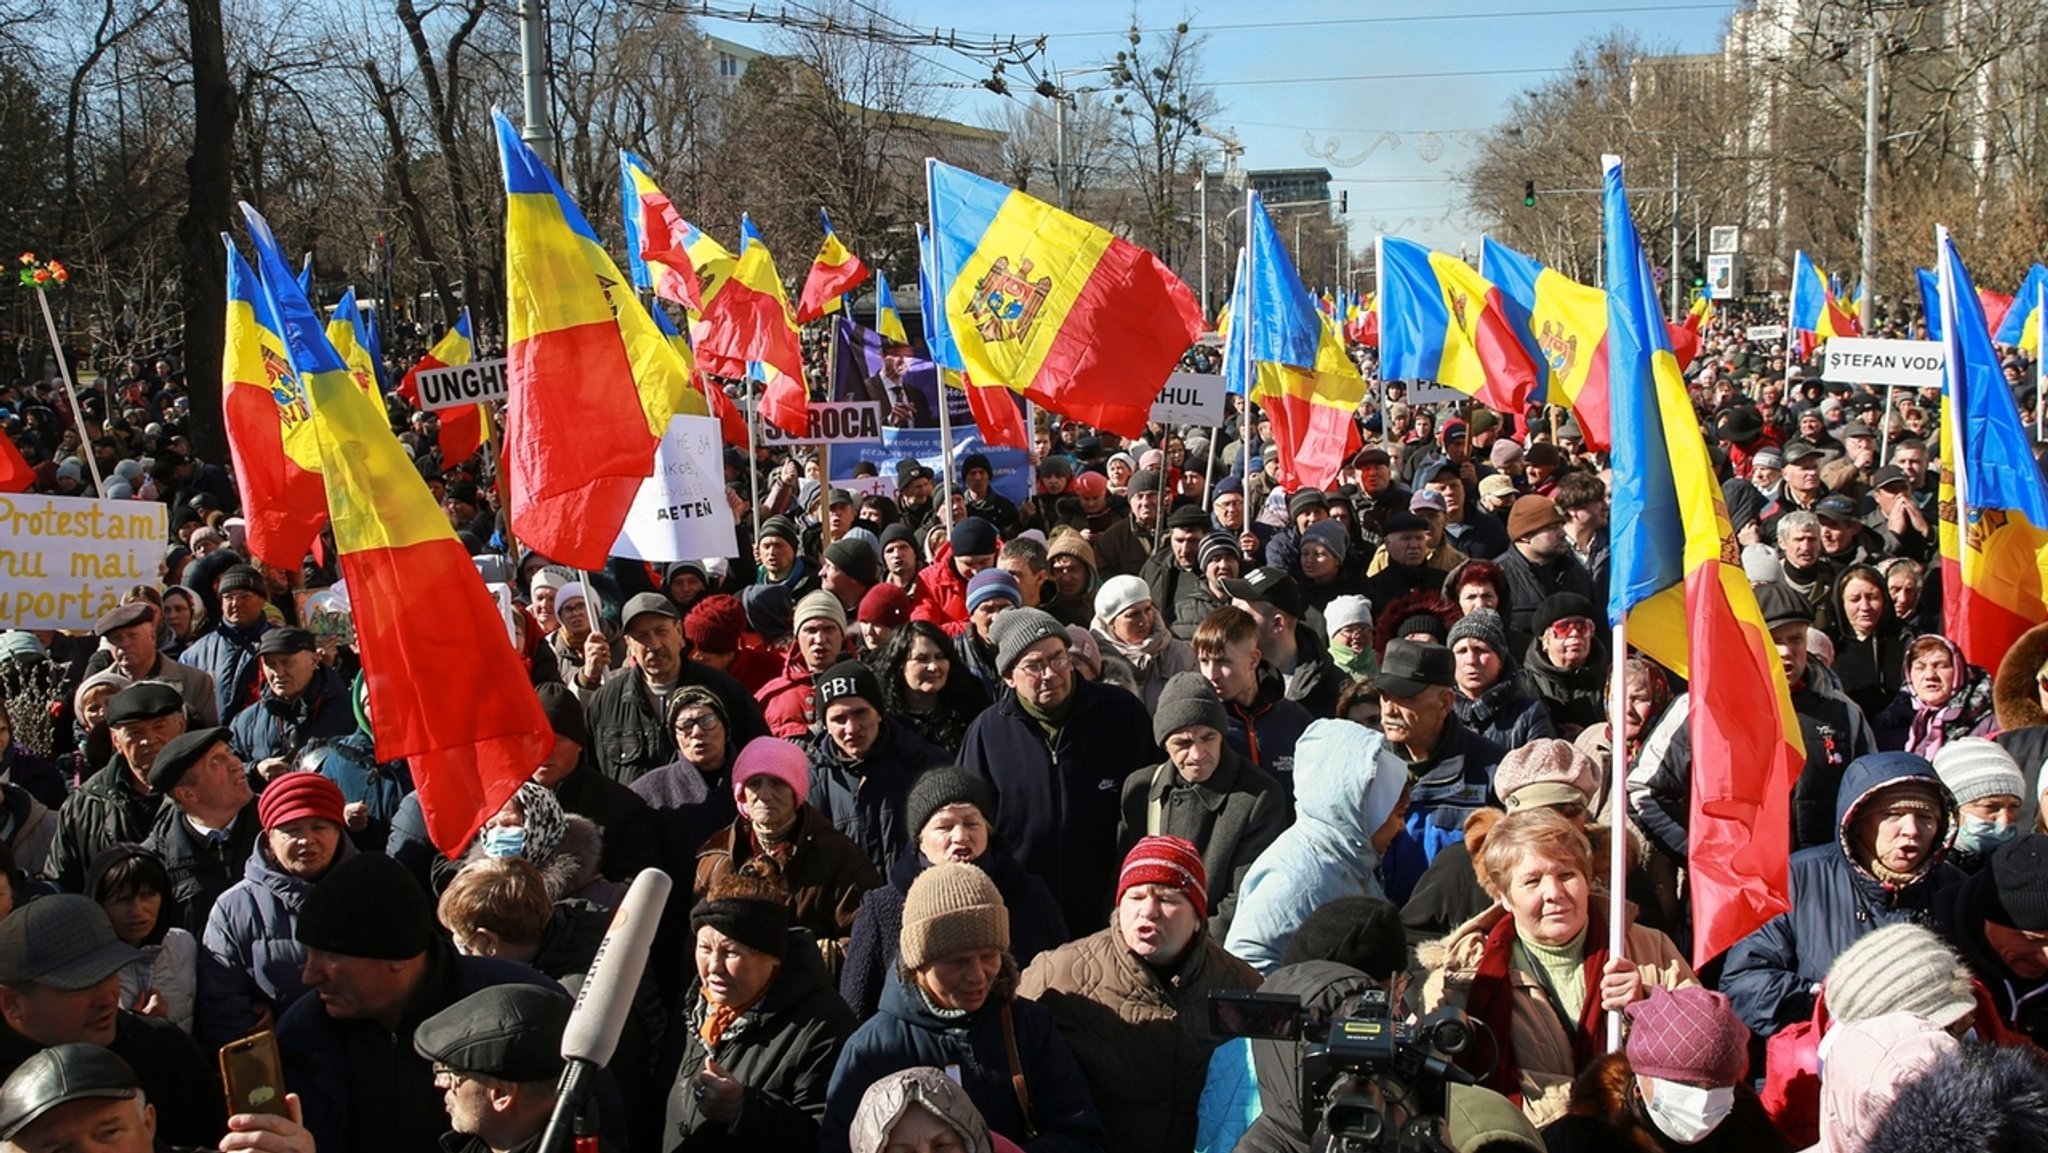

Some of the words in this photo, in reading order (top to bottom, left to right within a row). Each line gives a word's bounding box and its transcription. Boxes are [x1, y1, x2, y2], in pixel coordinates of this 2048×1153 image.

[1154, 387, 1204, 406] HUL
[656, 497, 713, 521] ДЕТЕЙ
[0, 550, 48, 577] nu
[70, 549, 143, 580] mai
[821, 677, 857, 702] FBI
